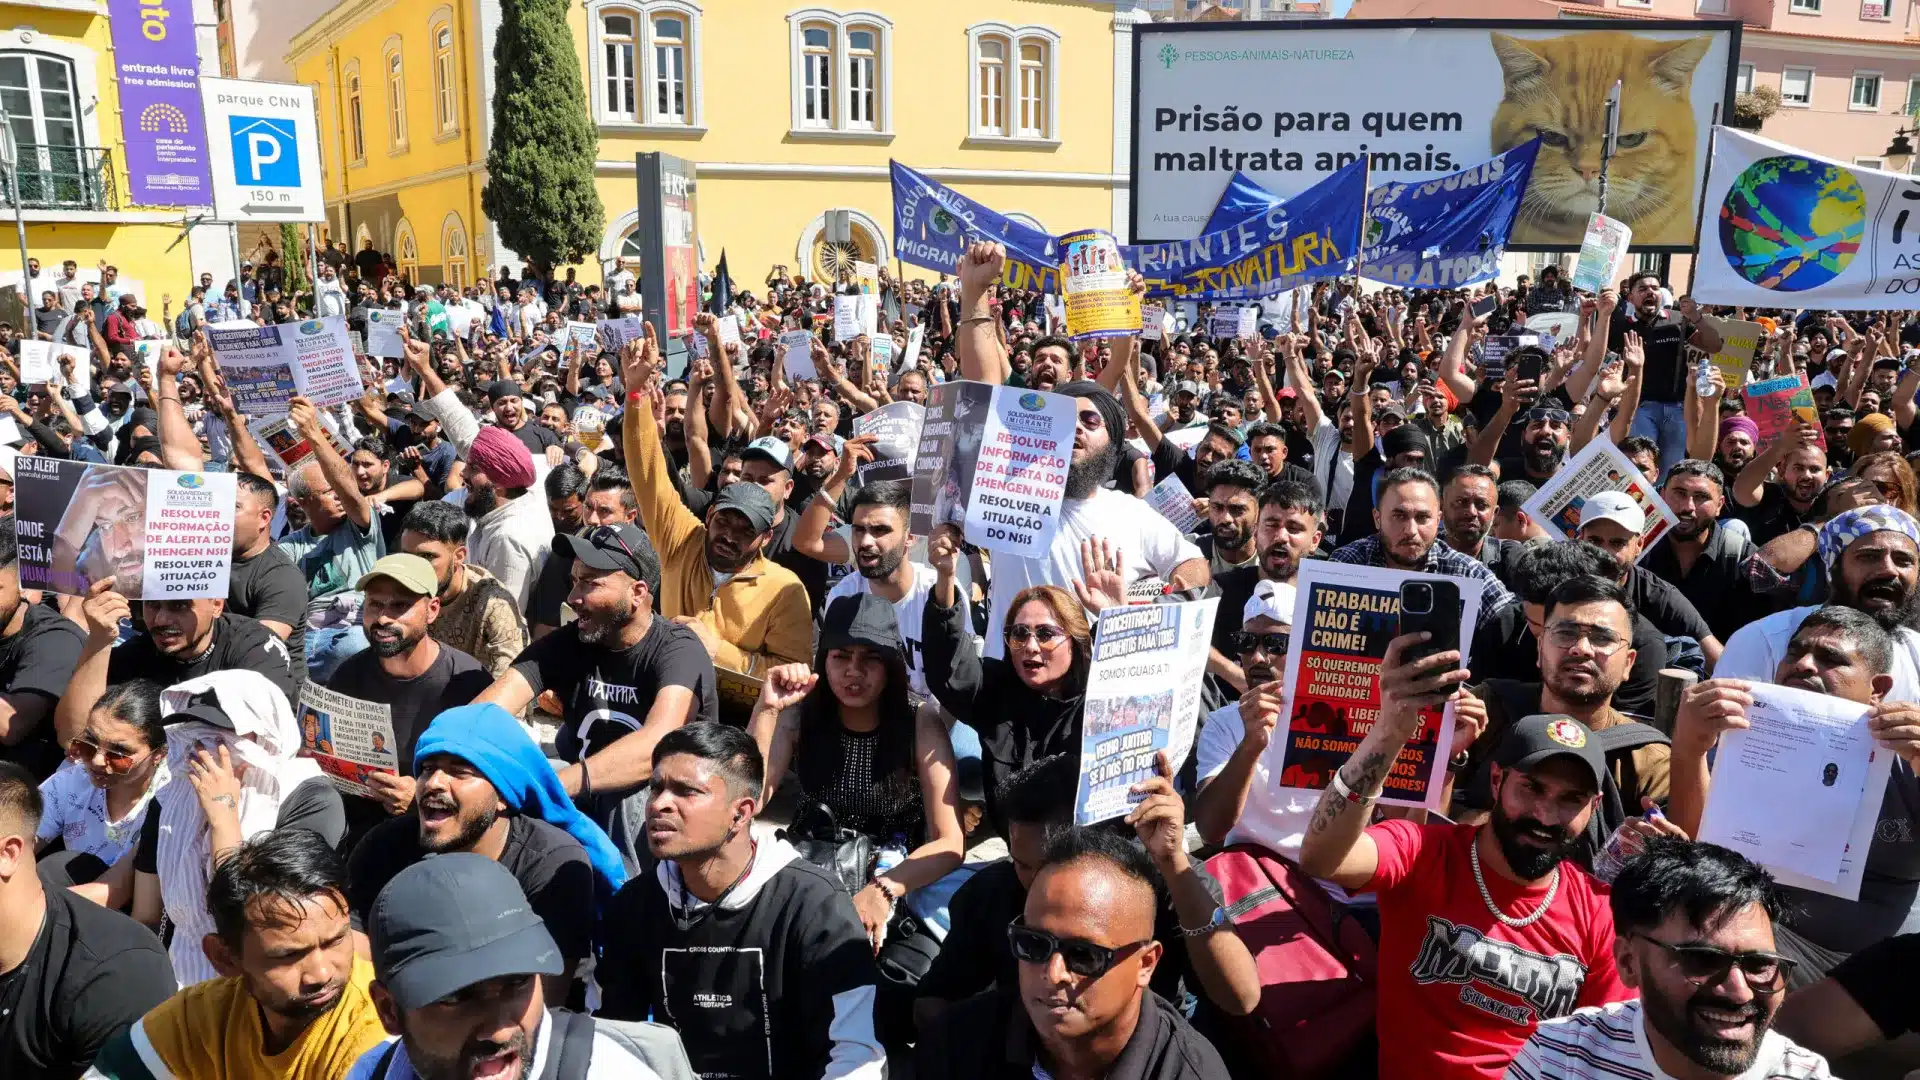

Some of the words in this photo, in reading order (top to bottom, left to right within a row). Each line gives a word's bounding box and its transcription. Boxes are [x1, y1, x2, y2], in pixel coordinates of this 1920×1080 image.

[1184, 49, 1355, 62] PESSOAS-ANIMAIS-NATUREZA
[122, 63, 168, 75] entrada
[170, 65, 195, 76] livre
[124, 76, 144, 86] free
[146, 78, 196, 89] admission
[217, 93, 264, 106] parque
[269, 95, 300, 108] CNN
[1154, 105, 1263, 132] Prisão
[1273, 111, 1350, 137] para
[1361, 111, 1463, 138] quem
[248, 132, 282, 181] P
[1154, 146, 1303, 172] maltrata
[251, 190, 274, 201] 150
[280, 193, 291, 202] m
[1153, 213, 1161, 223] A
[1163, 213, 1179, 223] tua
[1181, 214, 1210, 223] causa
[1006, 416, 1052, 429] IMIGRANTE
[1007, 410, 1053, 421] SOLIDARIEDADE
[997, 432, 1058, 451] RESOLVER
[17, 457, 32, 472] SIS
[34, 460, 60, 475] ALERT
[859, 461, 887, 473] DIREITOS
[886, 457, 909, 467] IGUAIS
[982, 446, 1066, 468] INFORMAÇÃO
[977, 461, 993, 473] DE
[995, 464, 1044, 481] ALERTA
[1049, 473, 1065, 485] DO
[975, 477, 1032, 495] SHENGEN
[1035, 487, 1060, 501] NSIS
[161, 509, 221, 519] RESOLVER
[979, 494, 1040, 514] RESOLVER
[1043, 505, 1052, 516] A
[16, 520, 45, 538] ONDE
[148, 520, 230, 533] INFORMAÇÃO
[982, 510, 1043, 531] SITUAÇÃO
[146, 535, 163, 544] DE
[165, 535, 211, 544] ALERTA
[213, 534, 231, 544] DO
[986, 528, 1006, 540] DO
[18, 543, 43, 562] ESTÁ
[46, 548, 53, 564] A
[147, 547, 203, 557] SHENGEN
[205, 547, 229, 556] NSIS
[154, 560, 211, 569] RESOLVER
[213, 559, 223, 568] A
[159, 570, 217, 582] SITUAÇÃO
[166, 583, 184, 591] DO
[1315, 588, 1400, 615] TRABALHA
[1101, 607, 1163, 636] CONCENTRAÇÃO
[1313, 609, 1346, 630] NÃO
[1350, 613, 1360, 632] É
[1098, 637, 1137, 661] DOCUMENTOS
[1137, 634, 1156, 654] PARA
[1156, 628, 1176, 648] TODOS
[1311, 629, 1367, 651] CRIME!
[1099, 667, 1127, 681] SOMOS
[1127, 664, 1156, 678] IGUAIS
[1156, 664, 1163, 673] A
[1163, 663, 1171, 673] TI
[1306, 655, 1321, 668] SÓ
[1322, 659, 1382, 675] QUEREMOS
[1314, 671, 1346, 686] VIVER
[1347, 673, 1372, 687] COM
[312, 686, 323, 699] NÃO
[324, 691, 353, 709] COMETEU
[355, 701, 384, 715] CRIMES
[1308, 684, 1371, 701] DIGNIDADE!
[1095, 736, 1119, 762] VENHA
[1120, 729, 1153, 754] JUNTAR
[1295, 737, 1320, 750] NÃO
[1321, 739, 1360, 755] SOMO
[1089, 768, 1099, 786] SE
[1099, 765, 1106, 780] A
[1105, 759, 1121, 778] NÓS
[1123, 757, 1136, 773] NO
[1136, 751, 1157, 770] PORT
[707, 946, 737, 954] COUNTRY
[693, 994, 733, 1002] ATHLETICS
